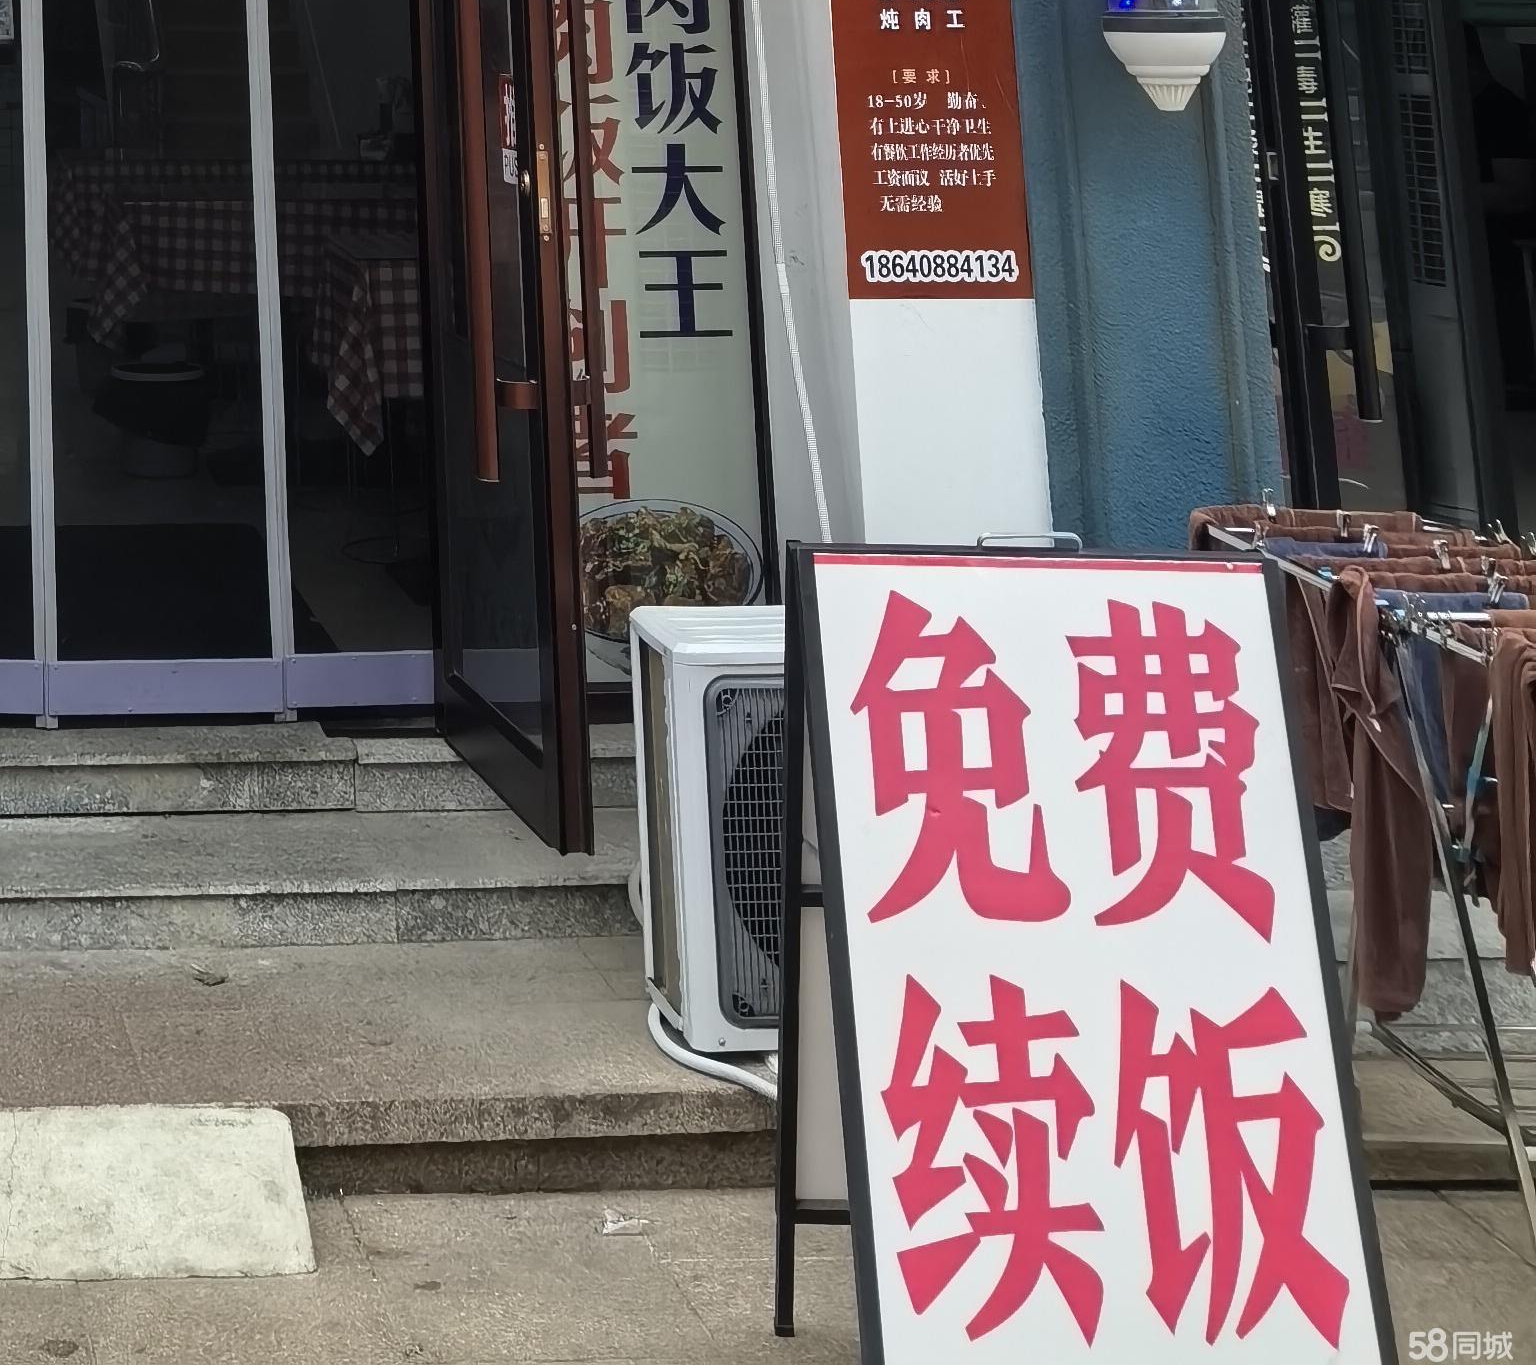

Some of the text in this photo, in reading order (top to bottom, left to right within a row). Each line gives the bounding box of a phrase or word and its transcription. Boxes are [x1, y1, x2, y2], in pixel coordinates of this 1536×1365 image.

[879, 7, 966, 31] 炖肉工
[867, 91, 928, 110] 18-50岁
[870, 142, 996, 162] 有餐饮工作经历者优先
[872, 169, 997, 188] 工资面议 活好上手
[879, 194, 944, 214] 无需经验
[864, 253, 1016, 280] 18640884134
[850, 588, 1277, 944] 免费
[880, 973, 1351, 1349] 续饭
